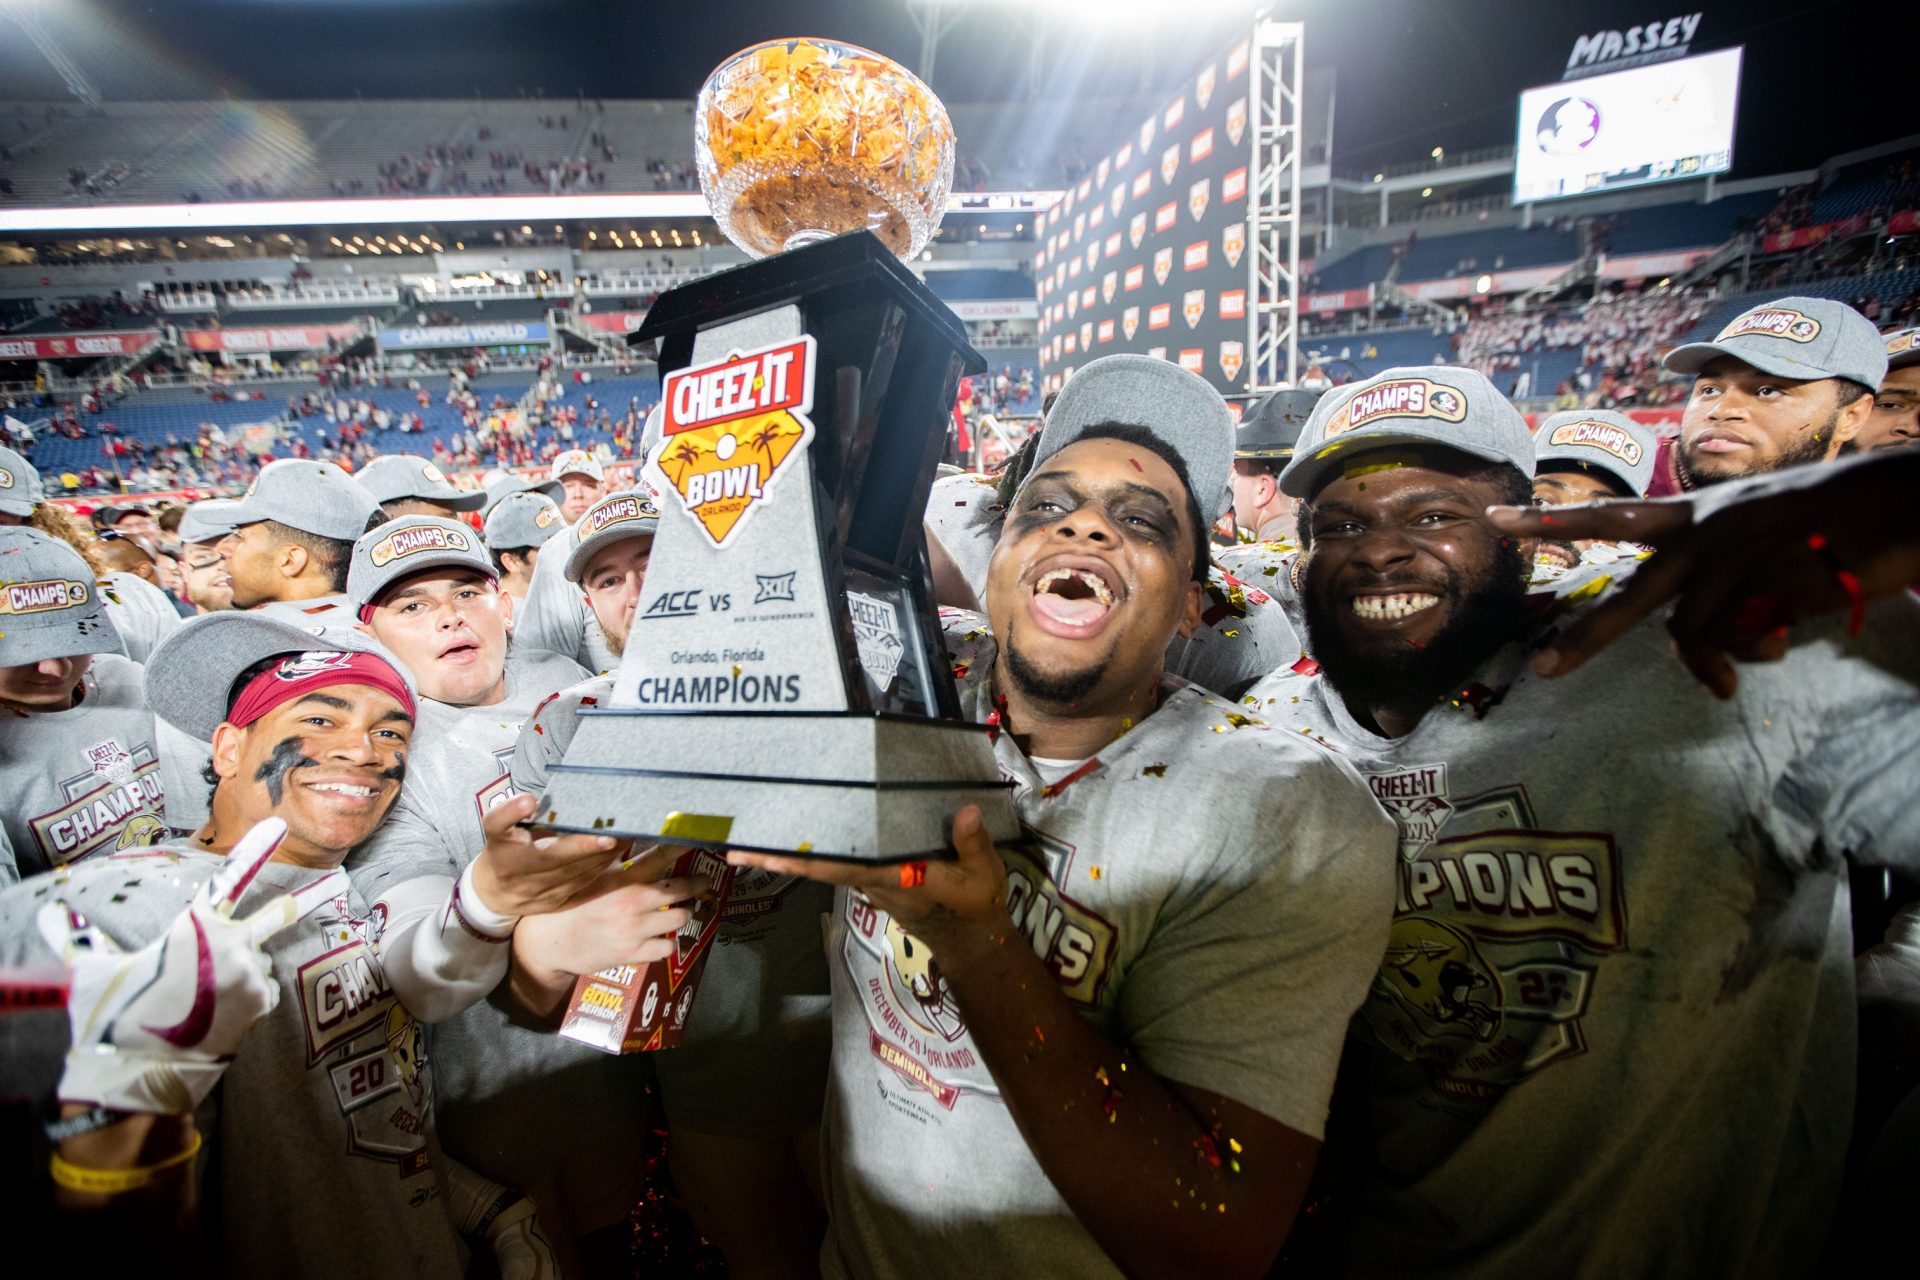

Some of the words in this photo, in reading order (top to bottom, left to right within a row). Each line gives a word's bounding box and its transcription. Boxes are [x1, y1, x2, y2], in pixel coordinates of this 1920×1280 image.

[1566, 11, 1703, 70] MASSEY
[400, 328, 469, 344] CAMPING
[471, 323, 527, 341] WORLD
[1739, 313, 1795, 334] CHAMPS
[1351, 384, 1425, 424] CHAMPS
[1575, 424, 1625, 453] CHAMPS
[686, 463, 763, 510] BOWL
[593, 500, 638, 528] CHAMPS
[702, 502, 742, 516] ORLANDO
[392, 529, 445, 554] CHAMPS
[10, 583, 68, 610] CHAMPS
[646, 590, 703, 614] ACC
[671, 651, 719, 665] Orlando,
[722, 649, 765, 662] Florida
[638, 675, 801, 704] CHAMPIONS
[1399, 823, 1434, 841] OWL
[1395, 851, 1599, 921] PIONS
[851, 902, 877, 939] 20
[578, 1002, 618, 1021] SEASON
[580, 985, 624, 1013] BOWL
[868, 977, 907, 1043] DECEMBER
[908, 1035, 921, 1055] 29
[927, 1048, 976, 1071] ORLANDO
[349, 1056, 385, 1098] 20
